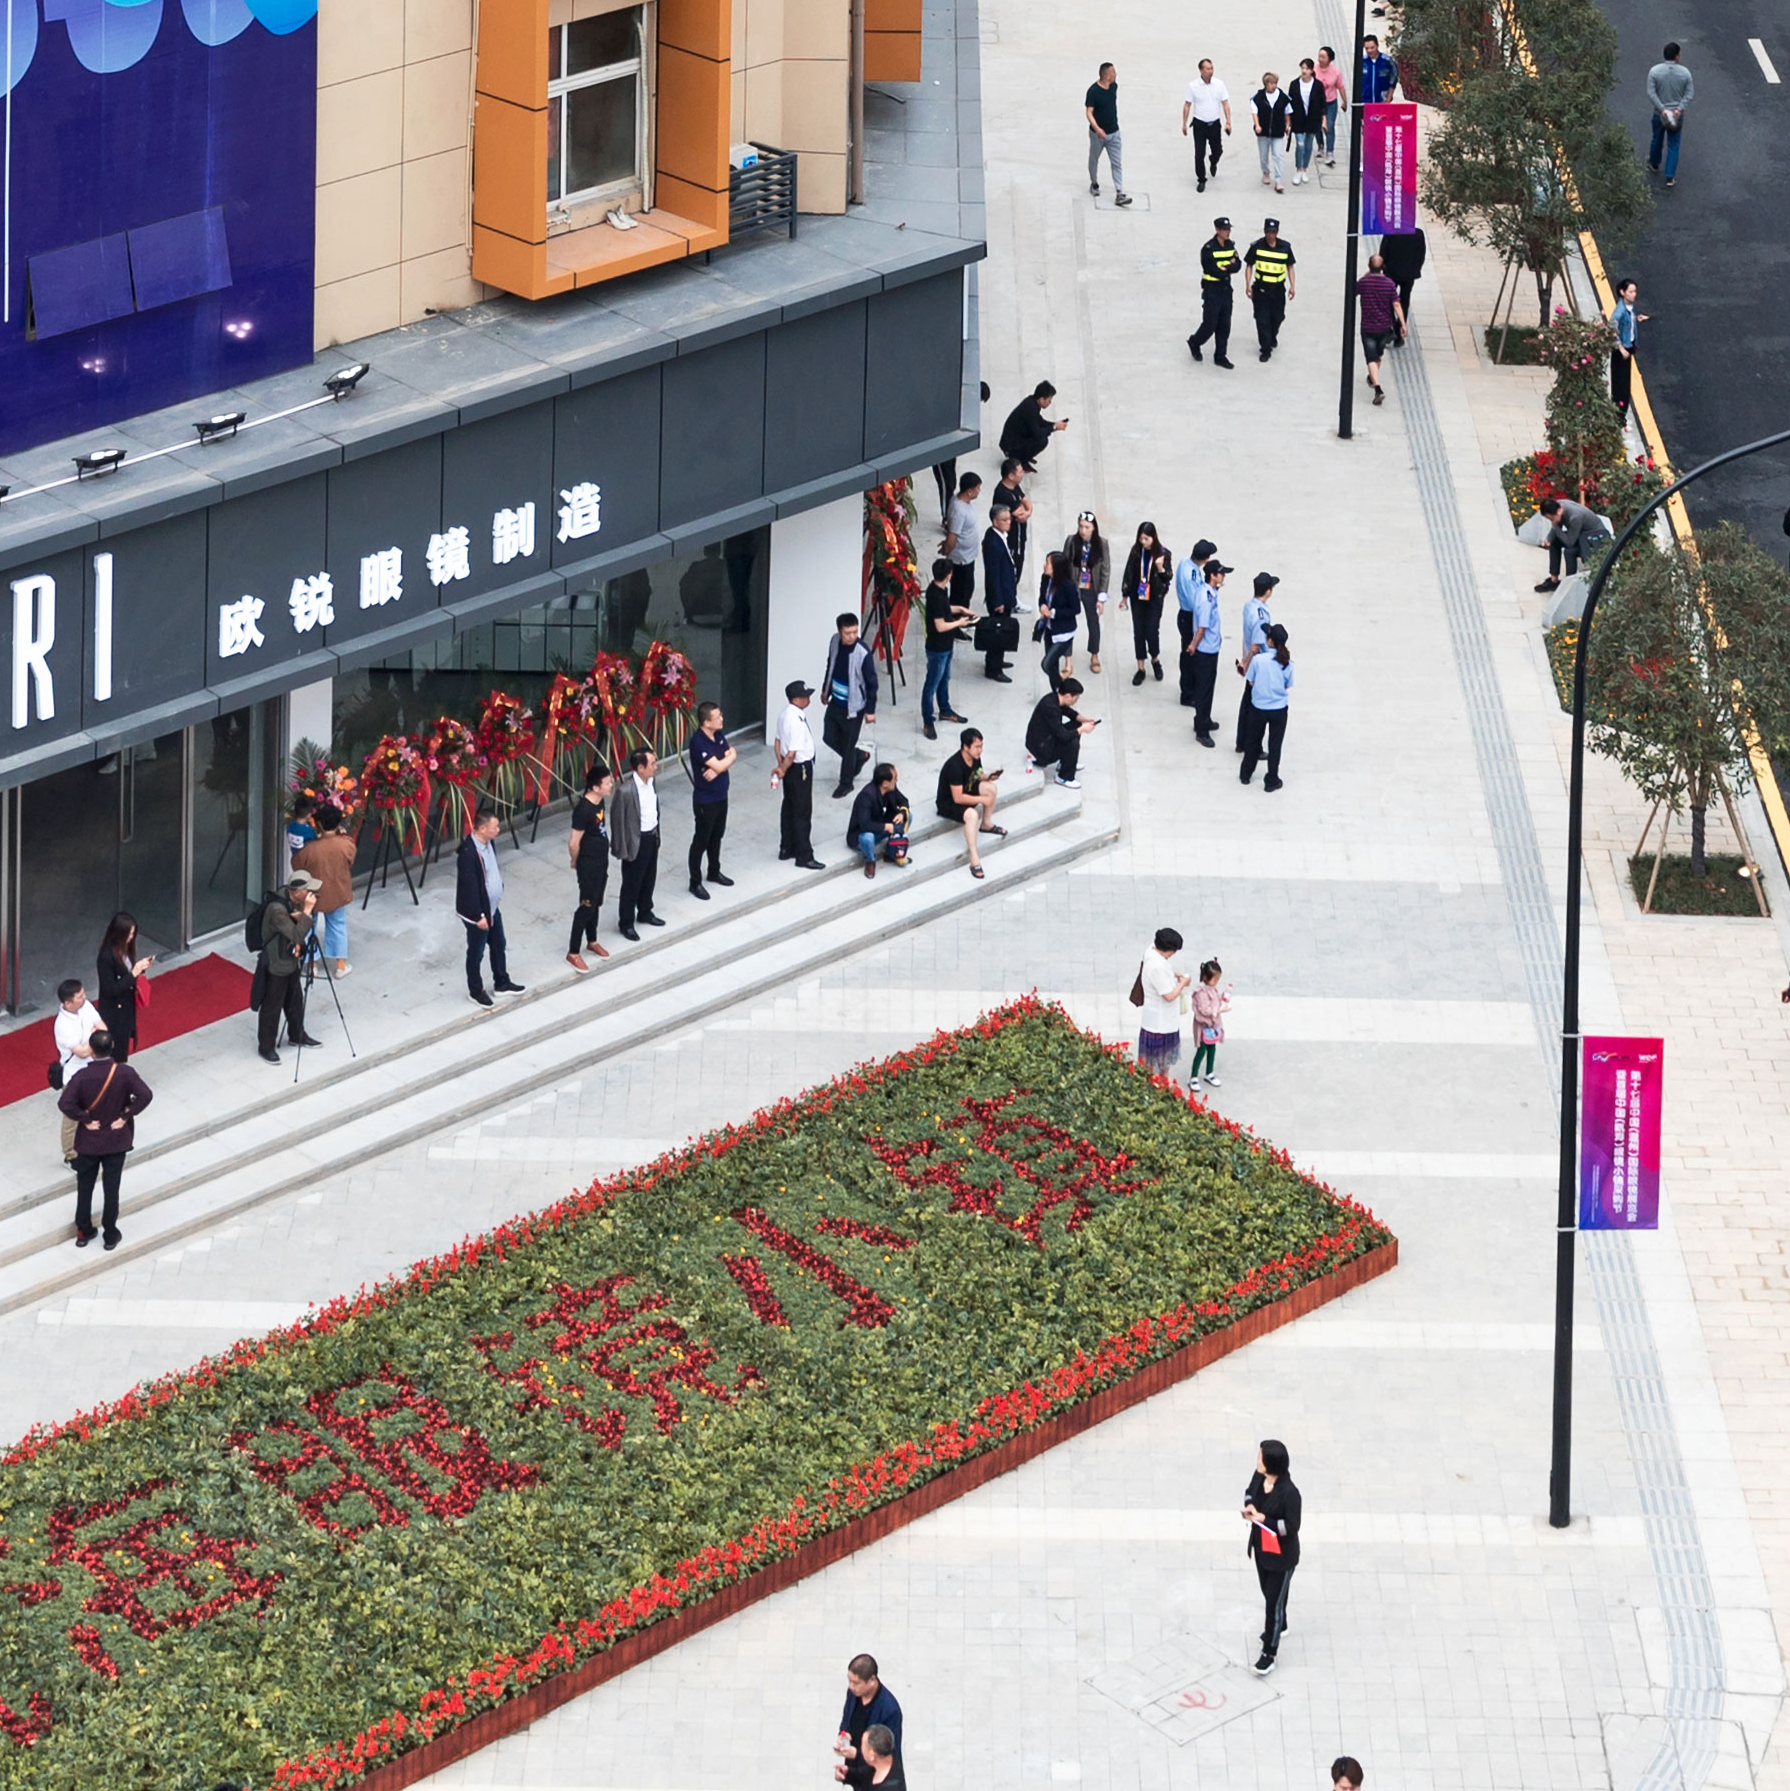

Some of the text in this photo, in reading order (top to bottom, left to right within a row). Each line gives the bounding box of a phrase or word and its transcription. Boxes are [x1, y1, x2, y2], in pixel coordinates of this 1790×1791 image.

[218, 481, 603, 658] 欧锐眼镜制造
